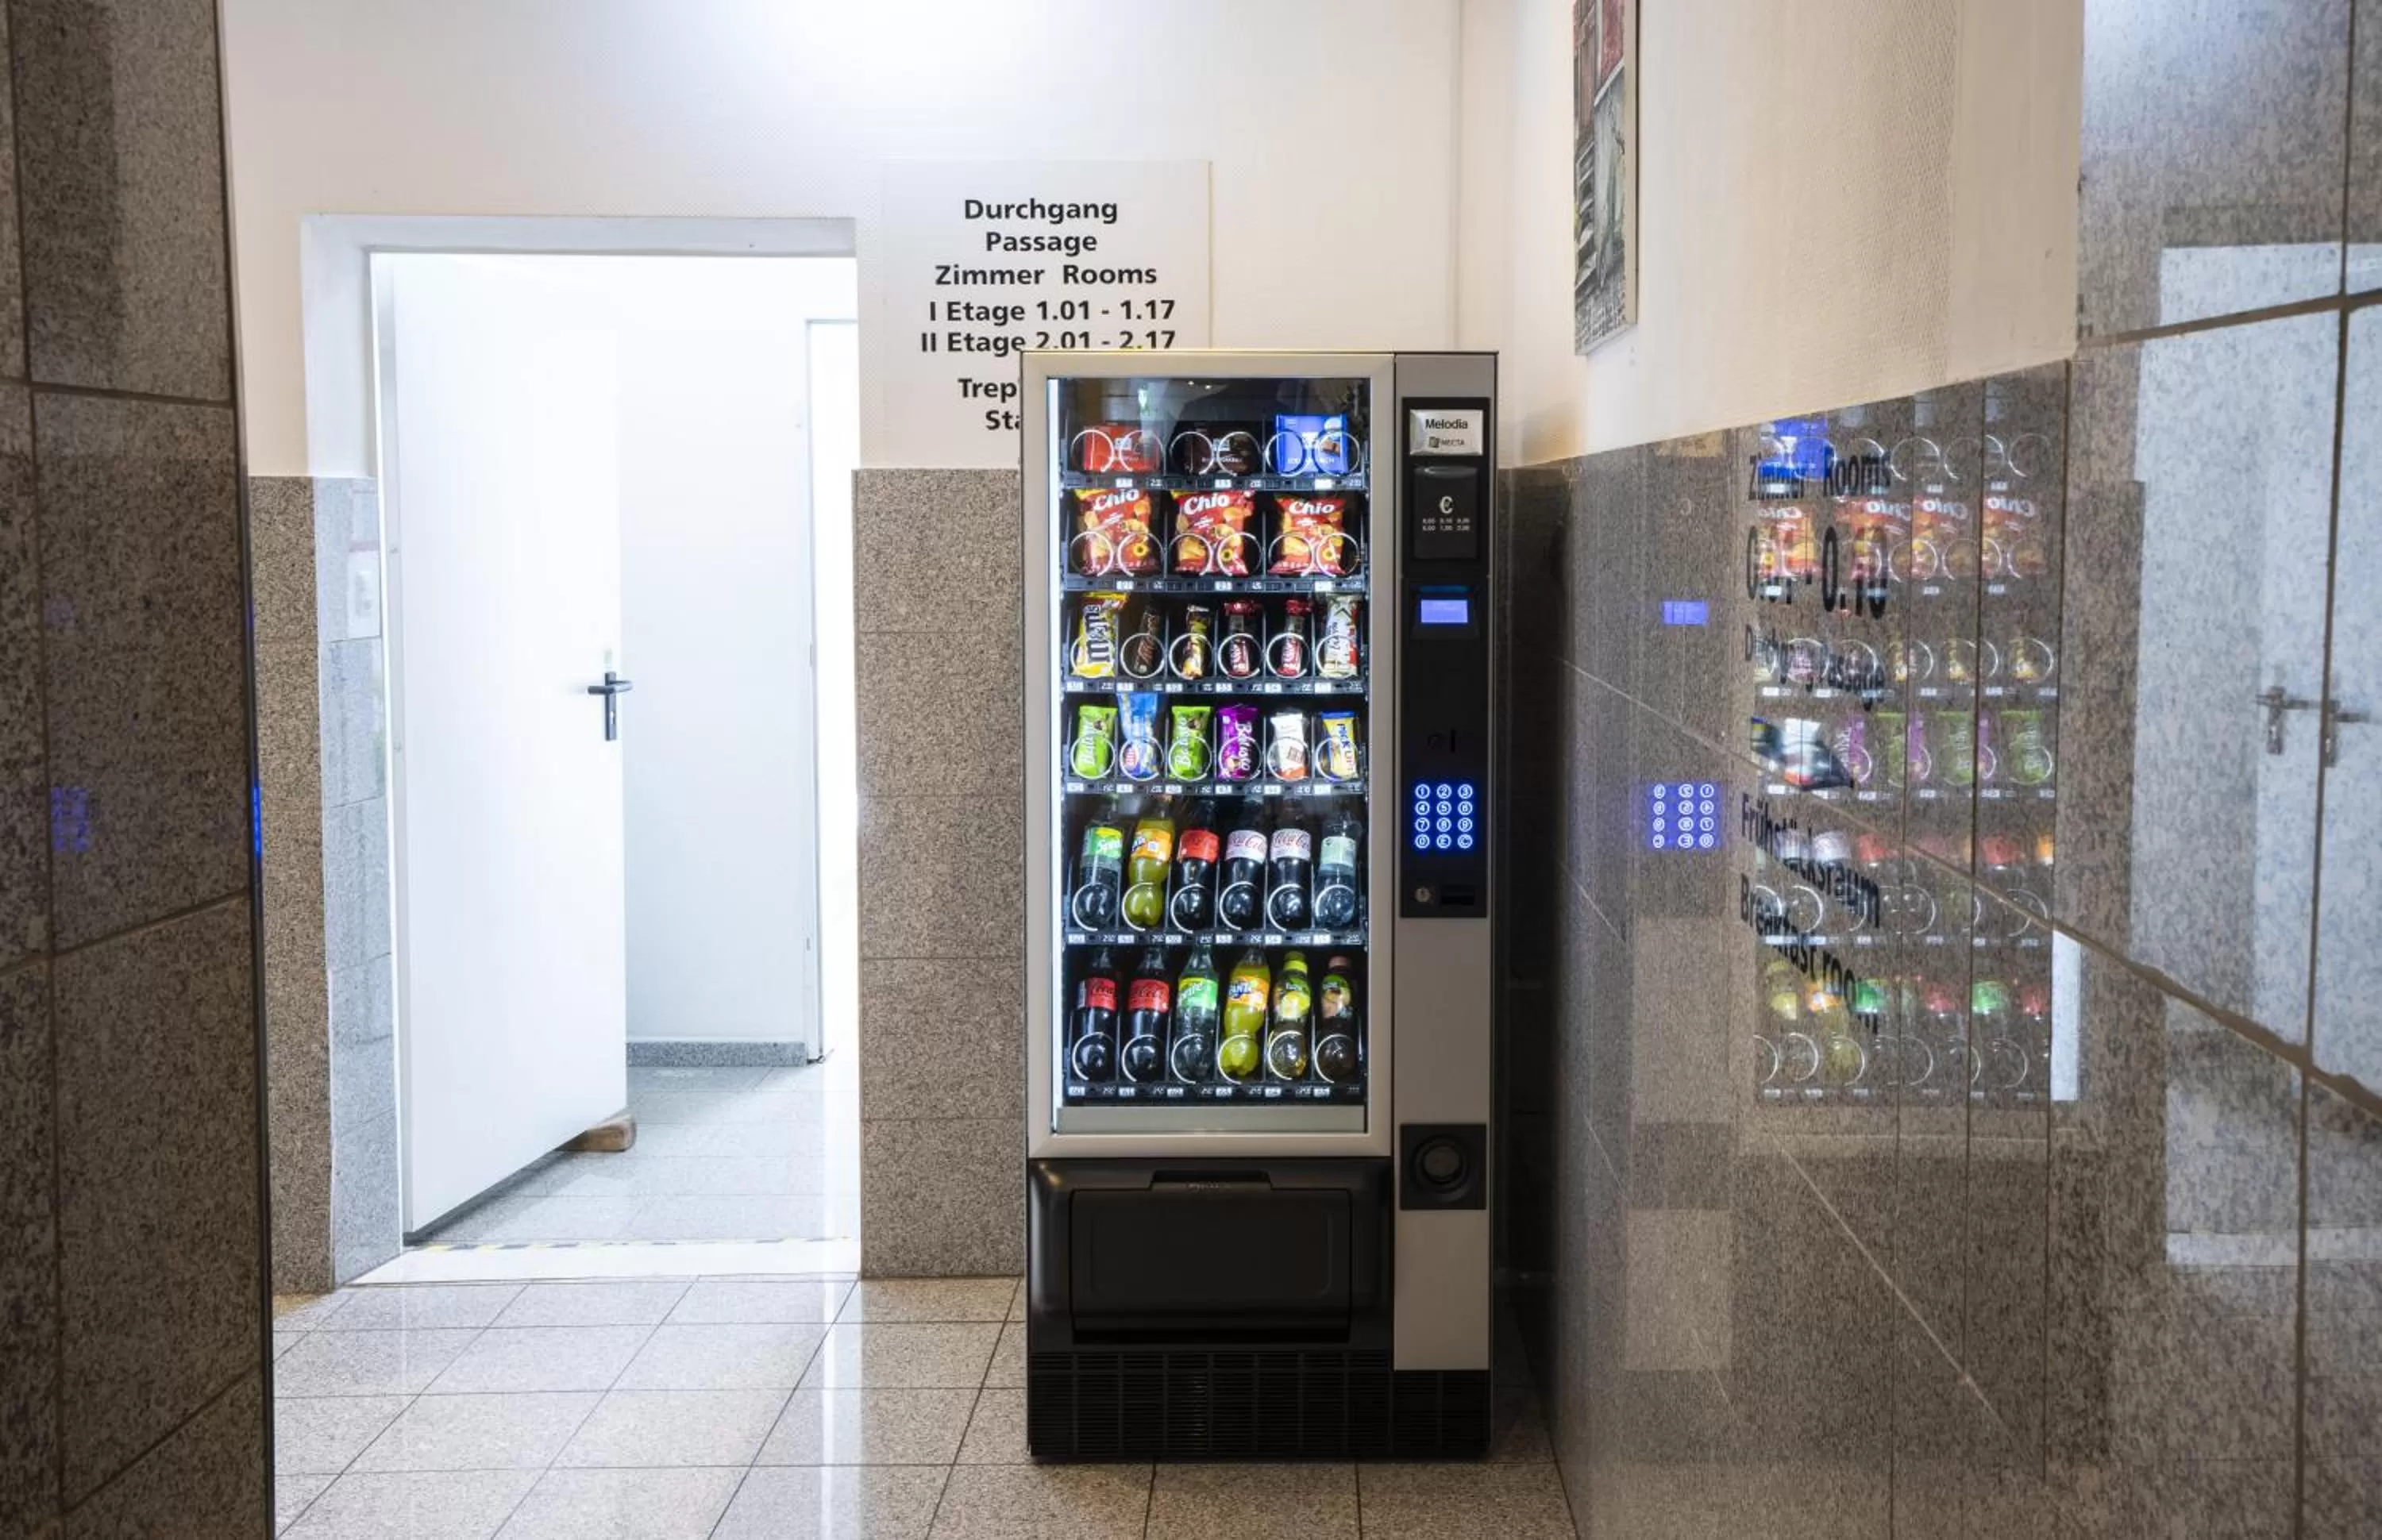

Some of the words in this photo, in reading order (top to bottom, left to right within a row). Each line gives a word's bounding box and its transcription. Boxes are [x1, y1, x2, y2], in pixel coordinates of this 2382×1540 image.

[965, 198, 1118, 225] Durchgang
[986, 232, 1097, 257] Passage
[935, 264, 1045, 285] Zimmer
[1063, 264, 1157, 285] Rooms
[929, 301, 936, 321] I
[947, 301, 1025, 326] Etage
[1036, 300, 1089, 321] 1.01
[1120, 299, 1175, 320] 1.17
[921, 333, 937, 352] II
[947, 332, 1027, 357] Etage
[1036, 331, 1089, 349] 2.01
[1120, 330, 1176, 349] 2.17
[1425, 418, 1469, 429] Melodia
[1093, 487, 1139, 512] Chio
[1183, 489, 1230, 514] Chio
[1289, 499, 1335, 514] Chio
